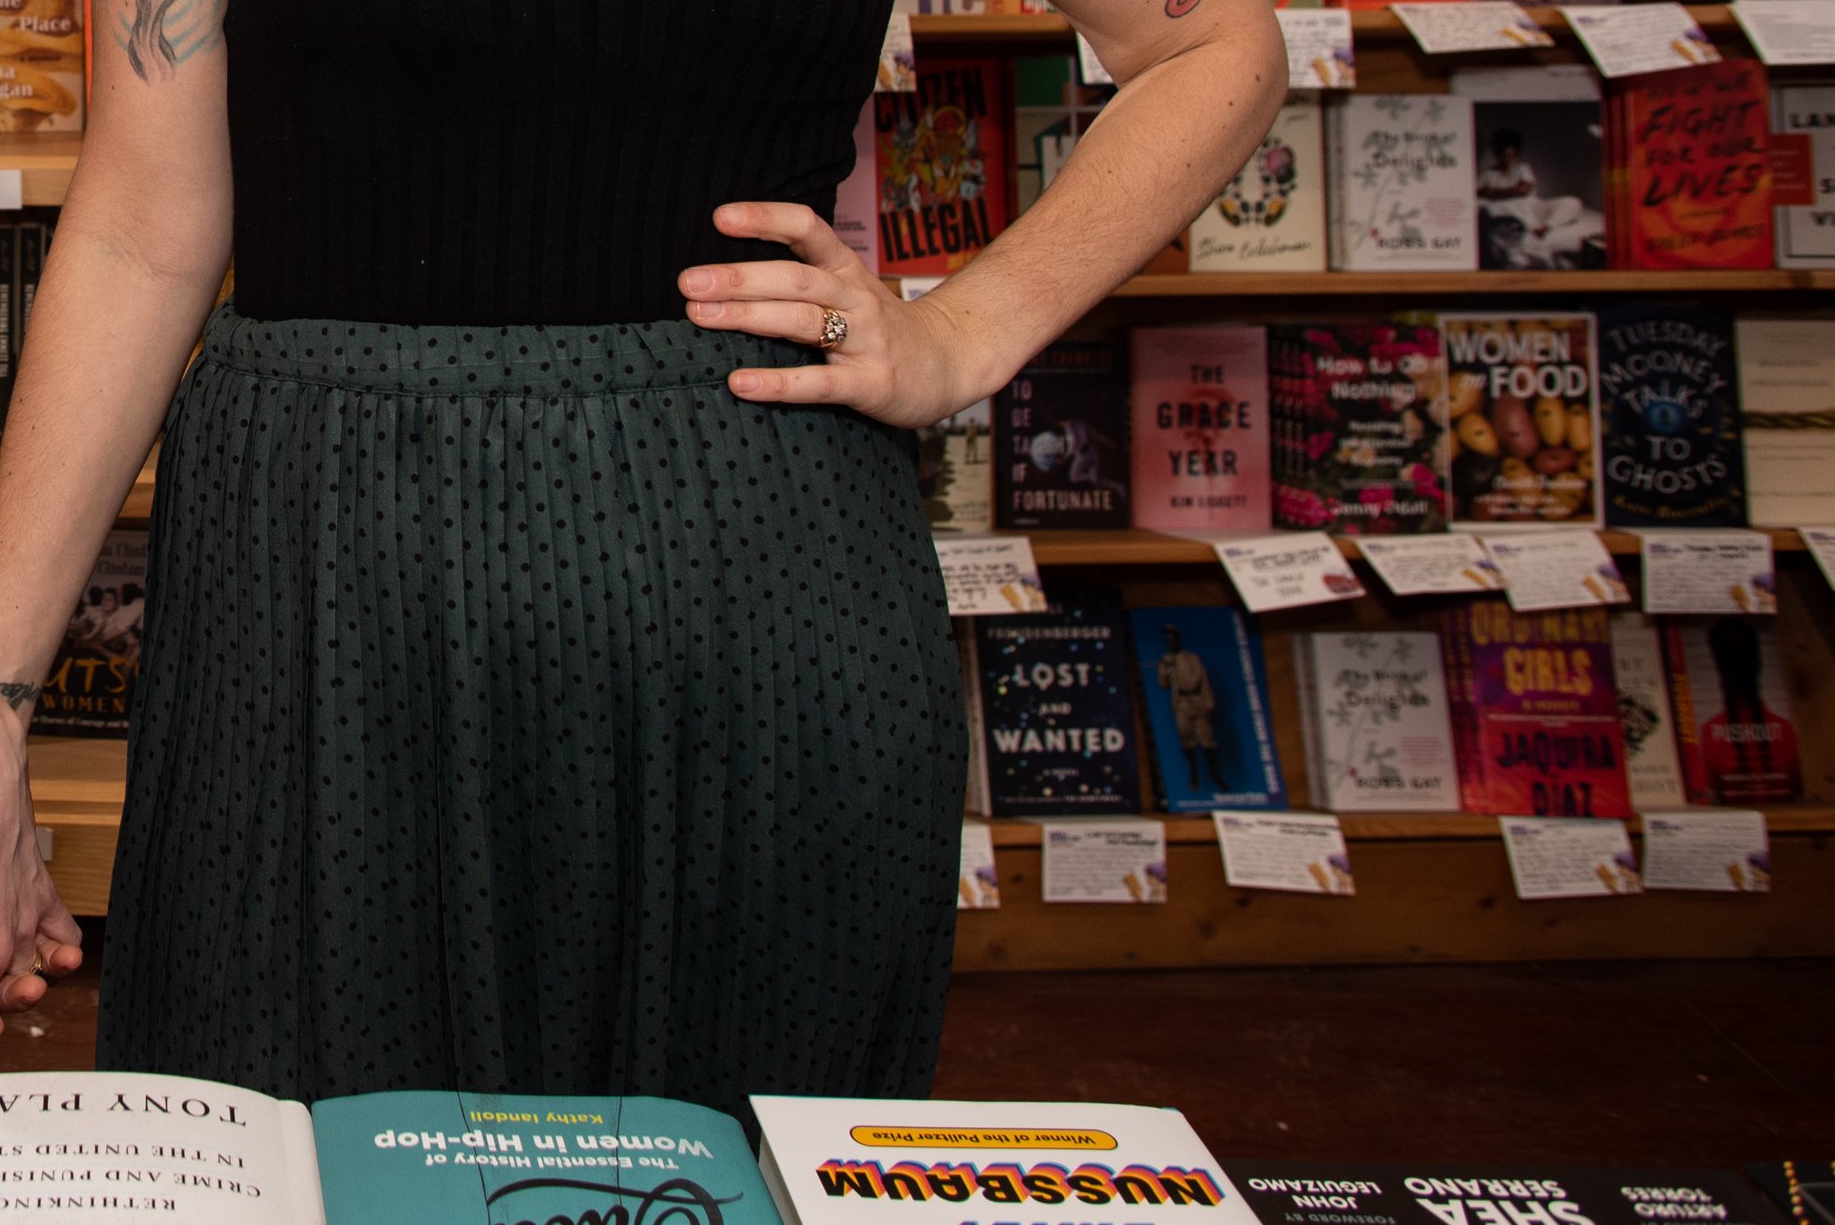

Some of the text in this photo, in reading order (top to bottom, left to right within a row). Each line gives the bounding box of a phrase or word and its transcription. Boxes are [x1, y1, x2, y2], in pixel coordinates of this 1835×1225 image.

[20, 16, 71, 32] Place
[1639, 100, 1762, 142] FIGHT
[1643, 163, 1765, 207] LIVES
[880, 198, 994, 264] ILLEGAL
[1447, 332, 1572, 364] WOMEN
[1608, 320, 1729, 356] TUESDAY
[1191, 365, 1225, 384] THE
[1316, 356, 1363, 374] How
[1601, 349, 1729, 395] MOONEY
[1331, 381, 1416, 403] Nothing
[1490, 366, 1589, 399] FOOD
[1621, 378, 1709, 419] TALKS
[1156, 402, 1253, 429] GRACE
[1645, 435, 1692, 462] TO
[1169, 449, 1239, 477] YEAR
[1607, 453, 1728, 494] GHOSTS
[1013, 489, 1113, 511] FORTUNATE
[1014, 663, 1092, 688] LOST
[1504, 648, 1594, 696] GIRLS
[42, 694, 125, 713] WOMEN
[1037, 702, 1072, 716] AND
[992, 729, 1126, 753] WANTED
[107, 1092, 247, 1127] TONY
[547, 1111, 604, 1126] Kathy
[373, 1128, 714, 1159] Women in Hip-Hop
[872, 1130, 1097, 1145] Winner of the Pulitzer Prize
[35, 1144, 140, 1156] UNITED
[151, 1145, 207, 1162] THE
[425, 1153, 680, 1170] The Essential History of
[216, 1156, 245, 1169] IN
[105, 1170, 161, 1183] AND
[174, 1173, 261, 1198] CRIME
[815, 1158, 1227, 1207] NUSSBAUM
[1248, 1177, 1382, 1194] LEGUIZAMO
[1403, 1176, 1567, 1199] SERRANO
[1291, 1194, 1358, 1210] JOHN
